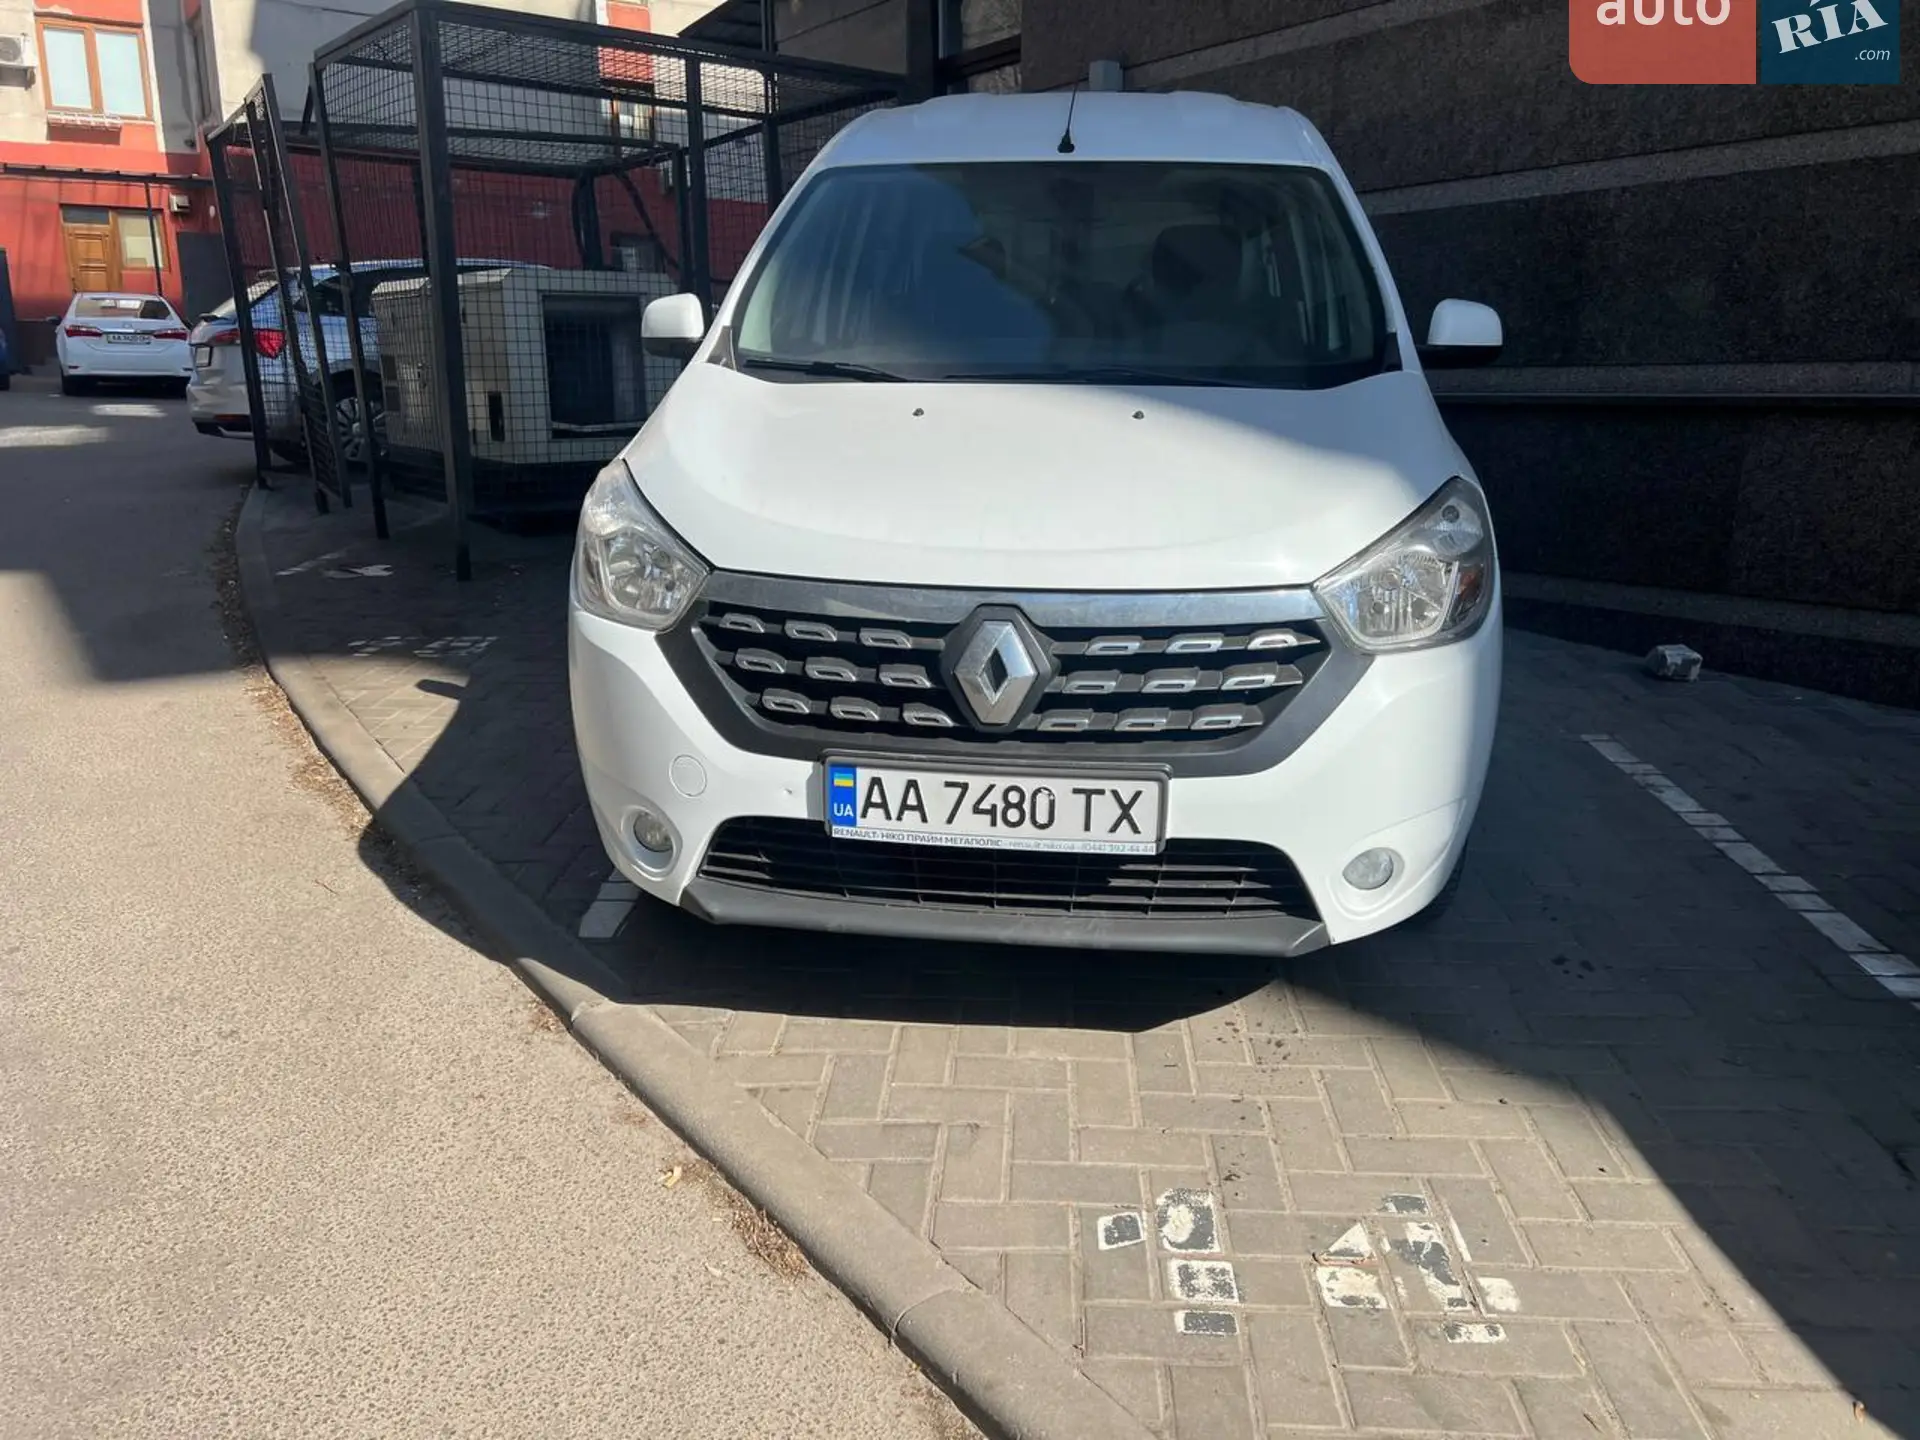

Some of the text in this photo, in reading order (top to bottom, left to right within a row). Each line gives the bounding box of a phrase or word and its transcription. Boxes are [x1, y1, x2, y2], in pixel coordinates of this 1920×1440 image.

[833, 803, 854, 817] UA
[860, 776, 1143, 834] AA 7480 TX
